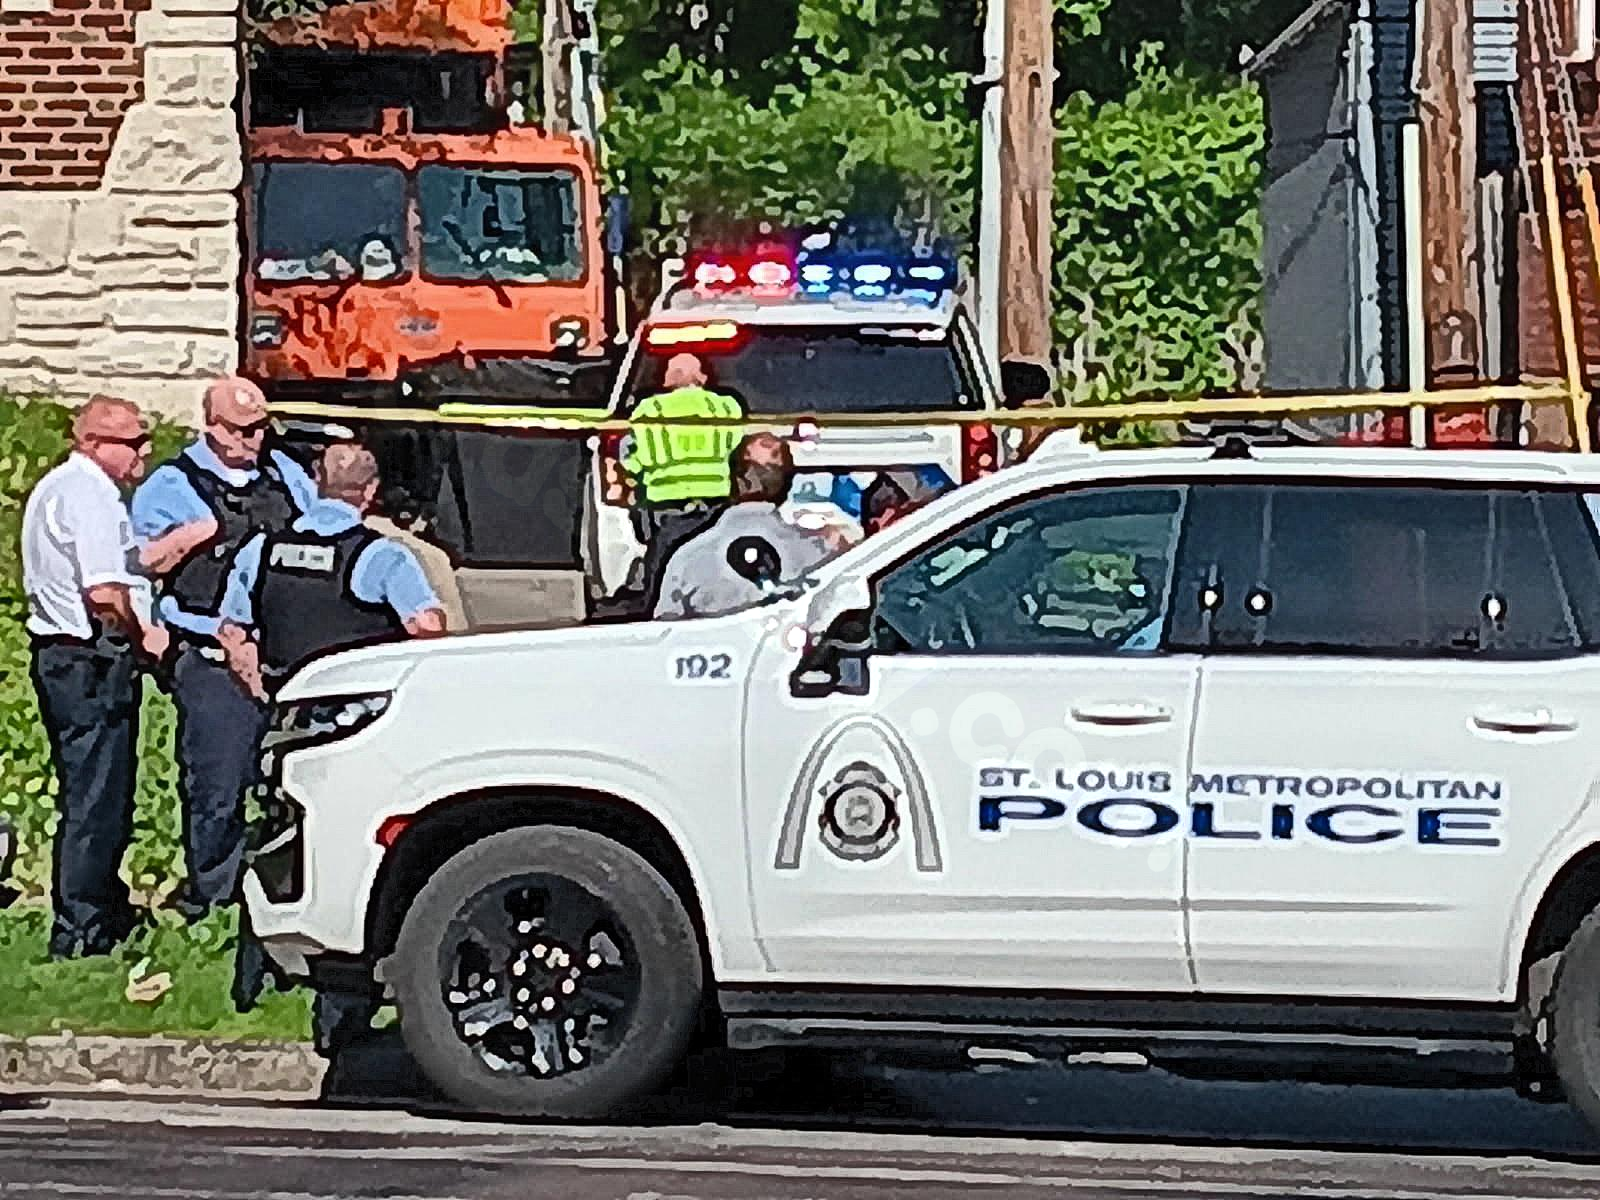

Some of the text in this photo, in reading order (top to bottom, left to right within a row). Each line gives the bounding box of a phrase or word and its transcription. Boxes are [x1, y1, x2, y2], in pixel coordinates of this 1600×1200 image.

[979, 767, 1501, 800] ST. LOUIS METROPOLITAN
[979, 796, 1501, 846] POLICE
